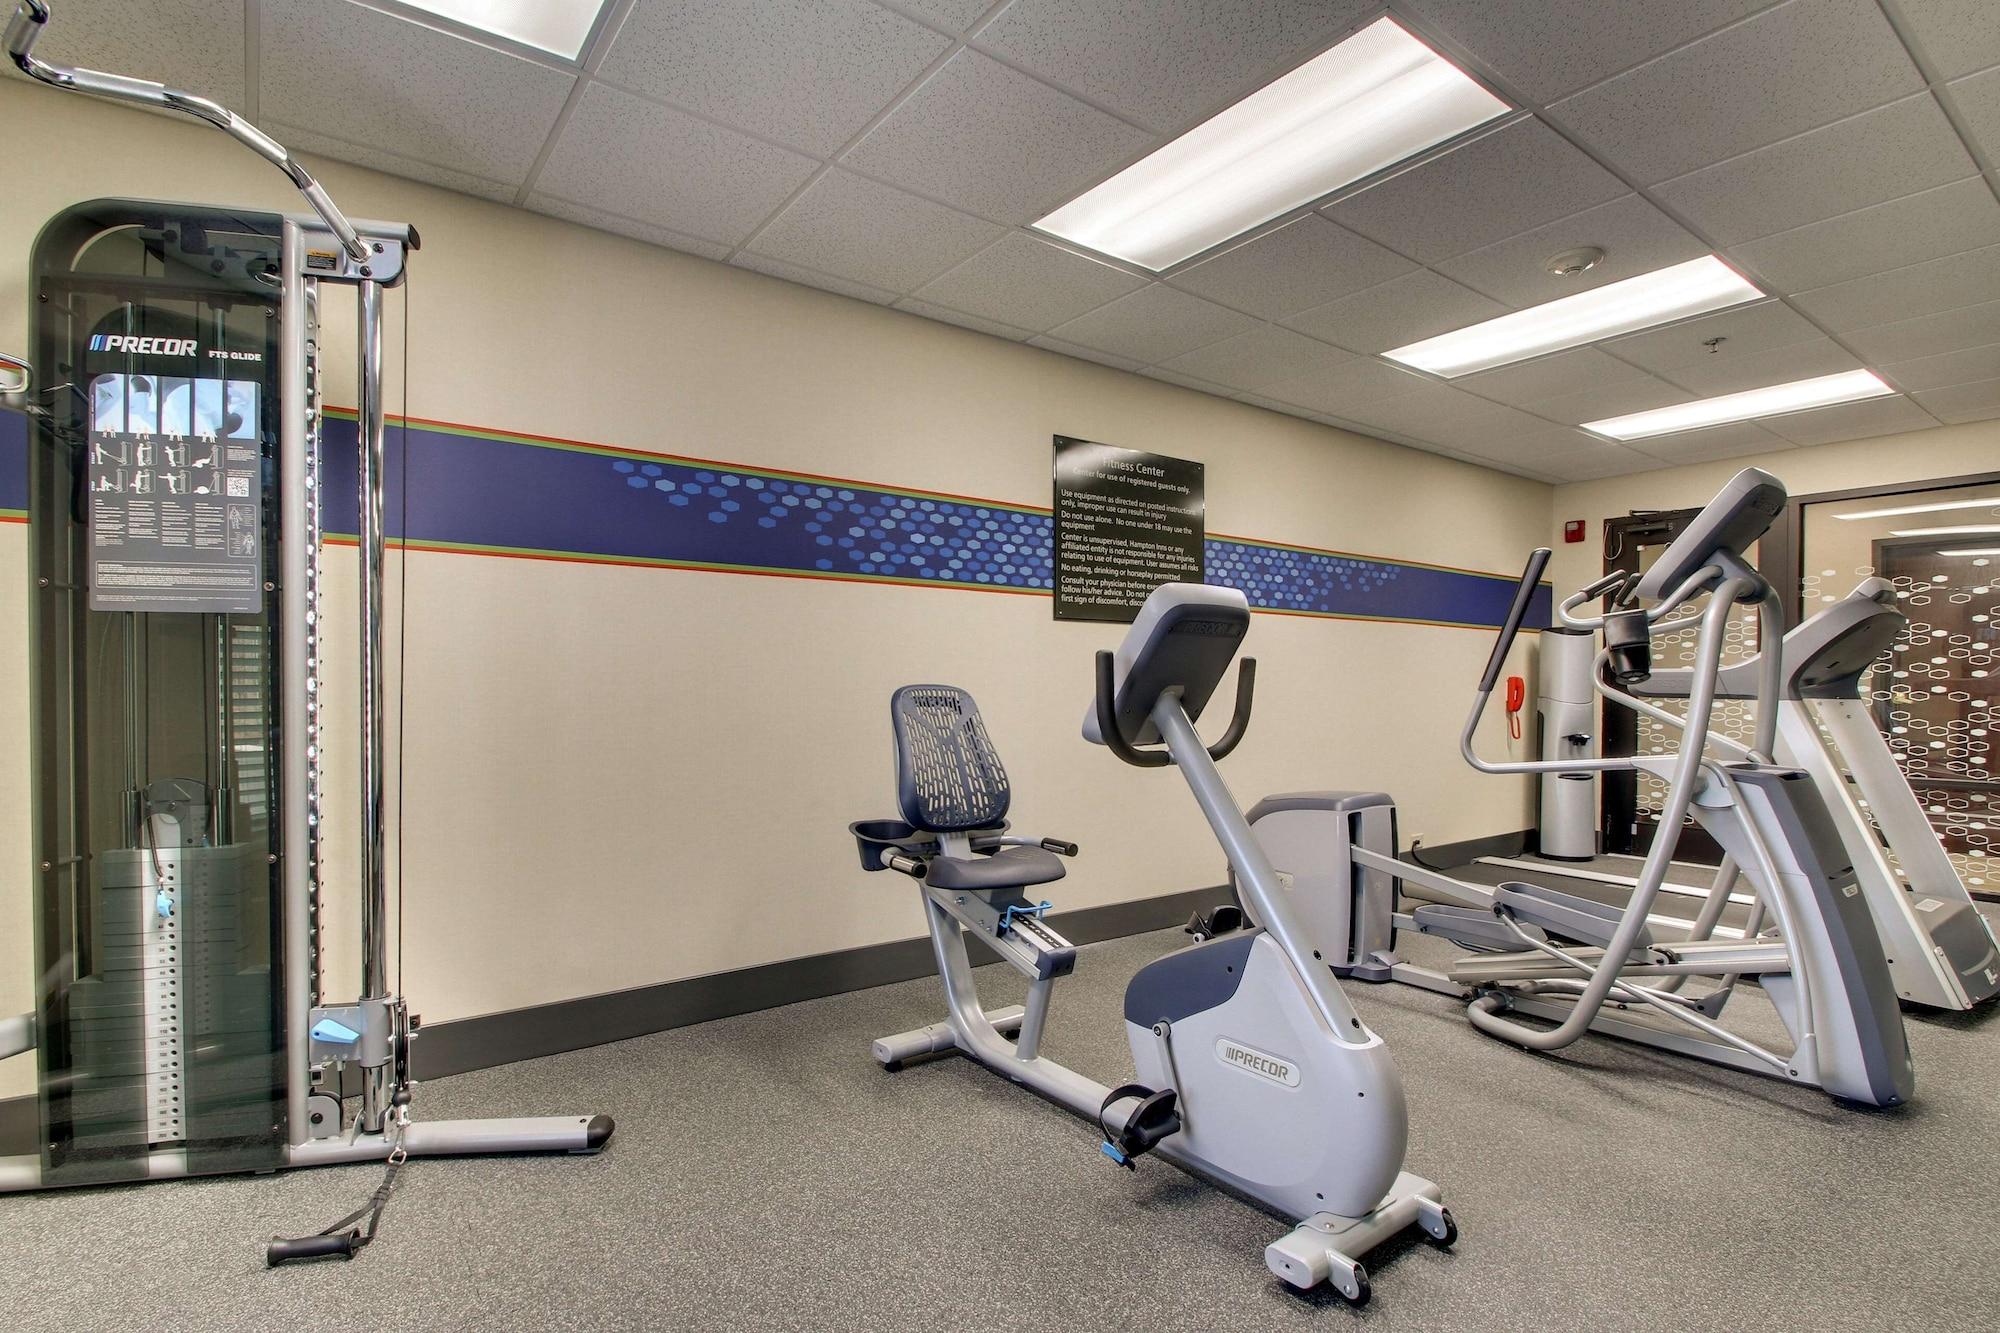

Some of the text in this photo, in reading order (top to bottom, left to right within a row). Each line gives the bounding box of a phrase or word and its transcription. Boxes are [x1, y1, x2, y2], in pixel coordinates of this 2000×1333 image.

[104, 335, 197, 357] PRECOR
[208, 350, 262, 362] FTS GLIDE
[1103, 457, 1165, 478] Fitness Center
[1096, 470, 1106, 479] for
[1107, 474, 1118, 482] use
[1119, 475, 1126, 483] of
[1127, 477, 1157, 487] registered
[1158, 482, 1176, 491] guests
[1061, 489, 1073, 498] Use
[1074, 492, 1106, 502] equipment
[1115, 497, 1138, 507] directed
[1147, 503, 1165, 511] posted
[1077, 500, 1105, 511] improper
[1145, 509, 1150, 517] in
[1151, 510, 1167, 521] injury
[1061, 510, 1071, 519] Do
[1137, 521, 1154, 529] under
[1162, 525, 1173, 534] may
[1183, 527, 1192, 535] the
[1061, 532, 1082, 541] Center
[1083, 534, 1088, 542] is
[1130, 540, 1155, 550] Hampton
[1156, 543, 1167, 551] Inns
[1174, 547, 1184, 557] any
[1061, 541, 1089, 551] affiliated
[1091, 545, 1108, 555] entity
[1109, 546, 1113, 554] is
[1114, 548, 1124, 556] not
[1126, 550, 1156, 559] responsible
[1157, 552, 1165, 560] for
[1166, 554, 1176, 562] any
[1061, 551, 1085, 562] relating
[1146, 559, 1158, 567] User
[1159, 561, 1180, 569] assumes
[1188, 564, 1198, 572] risks
[1061, 563, 1070, 571] No
[1094, 566, 1119, 577] drinking
[1126, 569, 1153, 580] horseplay
[1154, 573, 1180, 581] permitted
[1061, 575, 1085, 585] Consult
[1100, 579, 1126, 588] physician
[1127, 581, 1146, 589] before
[1061, 584, 1081, 593] follow
[1082, 586, 1102, 595] his/her
[1061, 594, 1073, 602] first
[1074, 595, 1087, 605] sign
[1234, 1050, 1289, 1080] PRECOR
